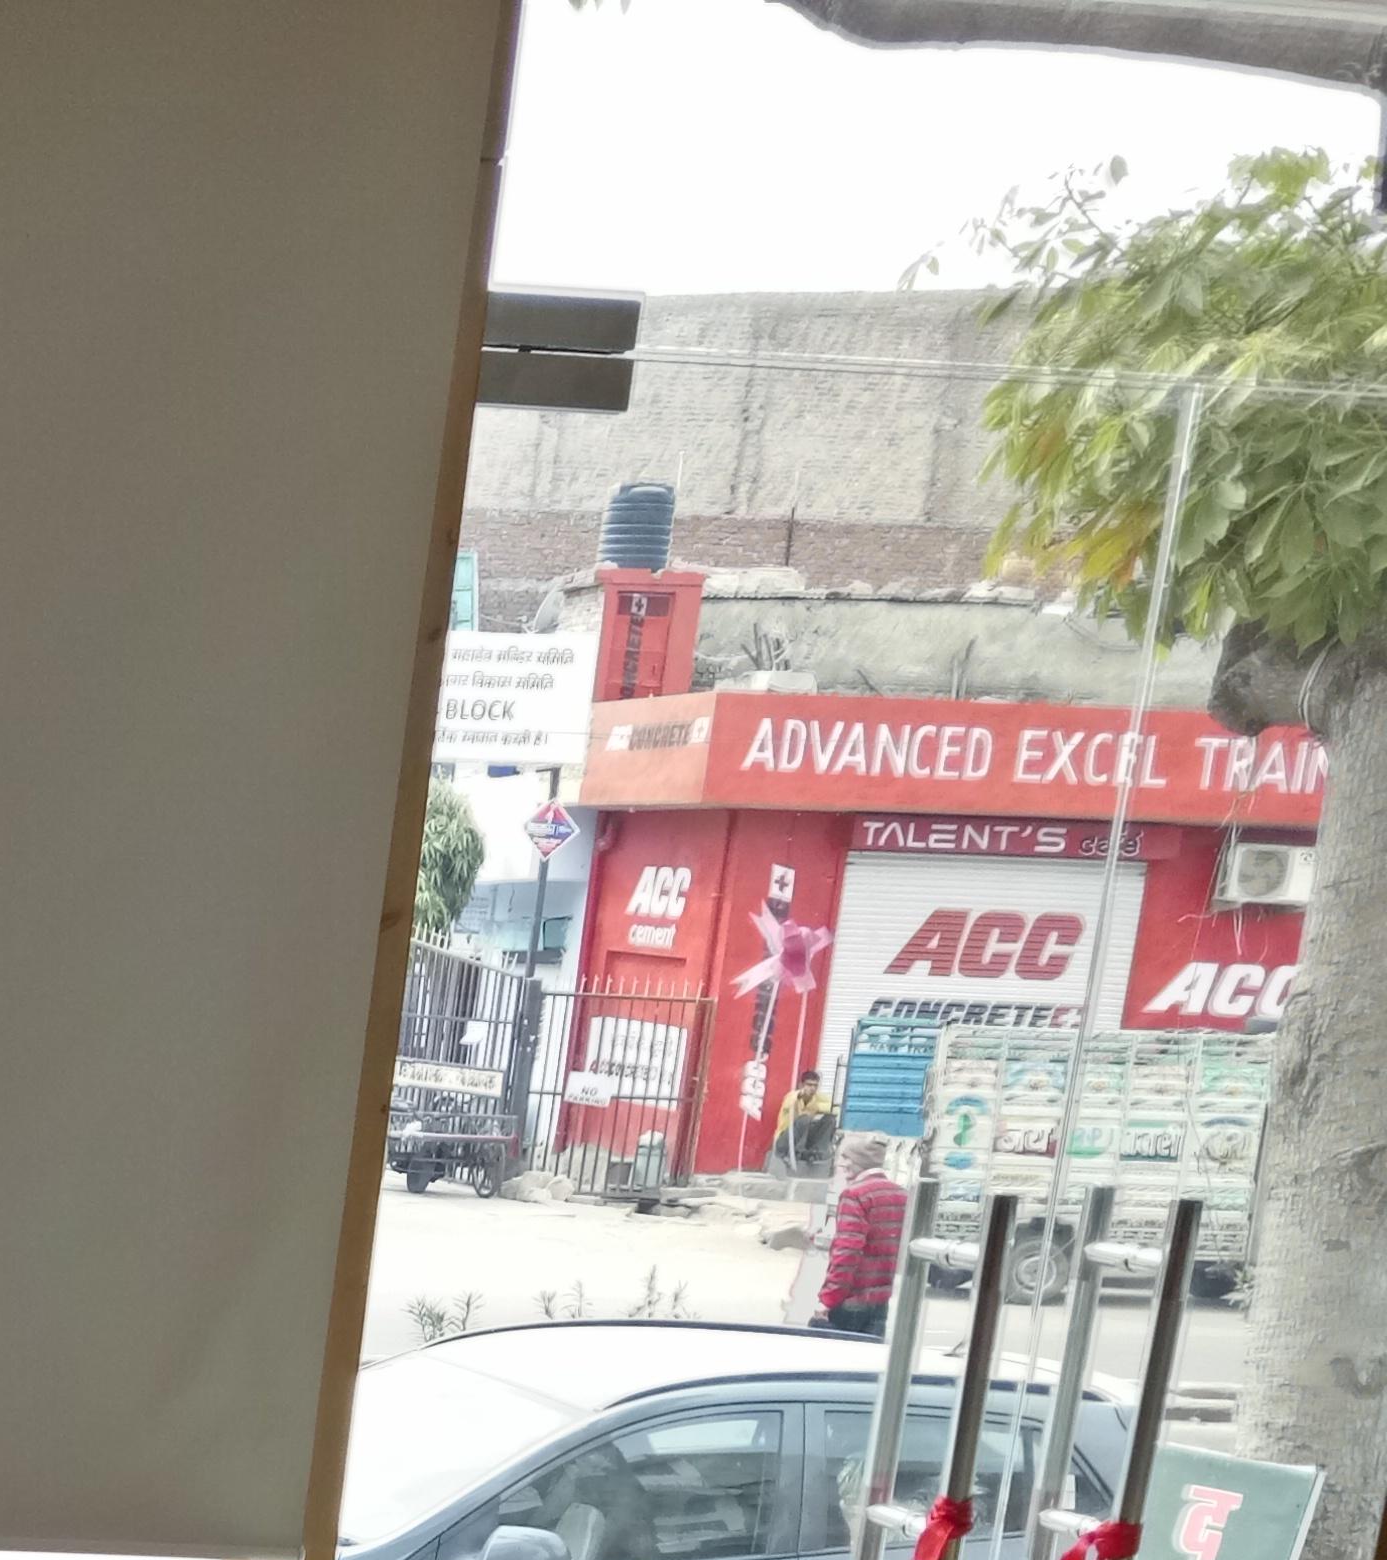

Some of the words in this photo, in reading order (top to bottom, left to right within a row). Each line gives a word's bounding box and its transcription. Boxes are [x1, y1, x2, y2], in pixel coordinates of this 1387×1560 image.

[445, 698, 516, 721] BLOCK
[740, 717, 993, 782] ADVANCED
[1013, 727, 1169, 790] EXCEL
[863, 821, 1068, 853] TALENT'S
[624, 865, 692, 921] ACC
[628, 923, 677, 950] cement
[882, 906, 1087, 982] ACC
[867, 996, 1055, 1029] CONCRETE
[580, 1085, 599, 1097] NO
[738, 1060, 768, 1122] ACC
